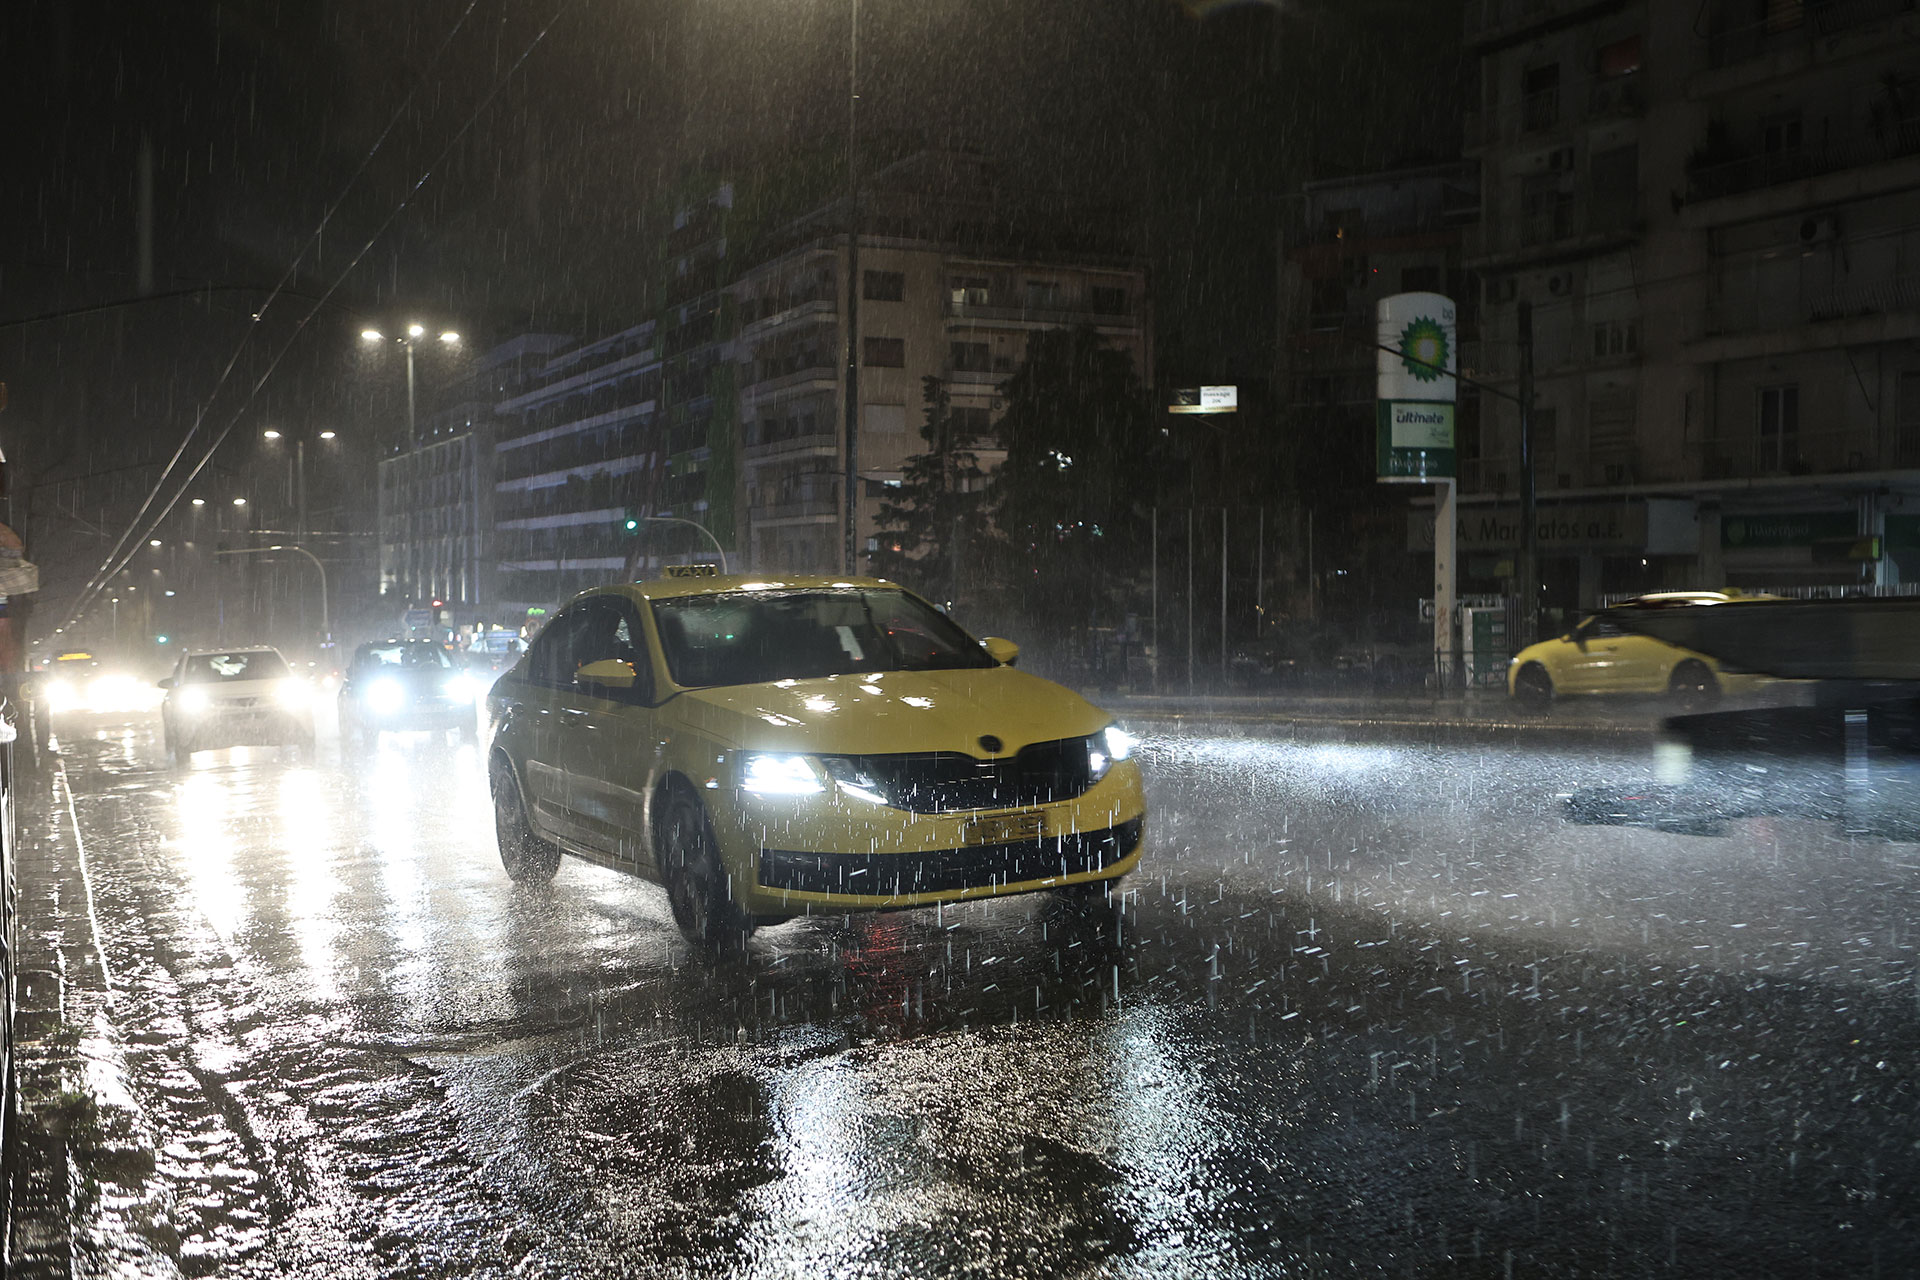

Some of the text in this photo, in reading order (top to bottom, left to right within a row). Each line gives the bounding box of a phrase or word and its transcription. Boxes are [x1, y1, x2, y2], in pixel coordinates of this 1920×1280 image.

[1442, 305, 1454, 321] bp
[1396, 411, 1444, 424] ultimate
[668, 566, 710, 577] TAXI
